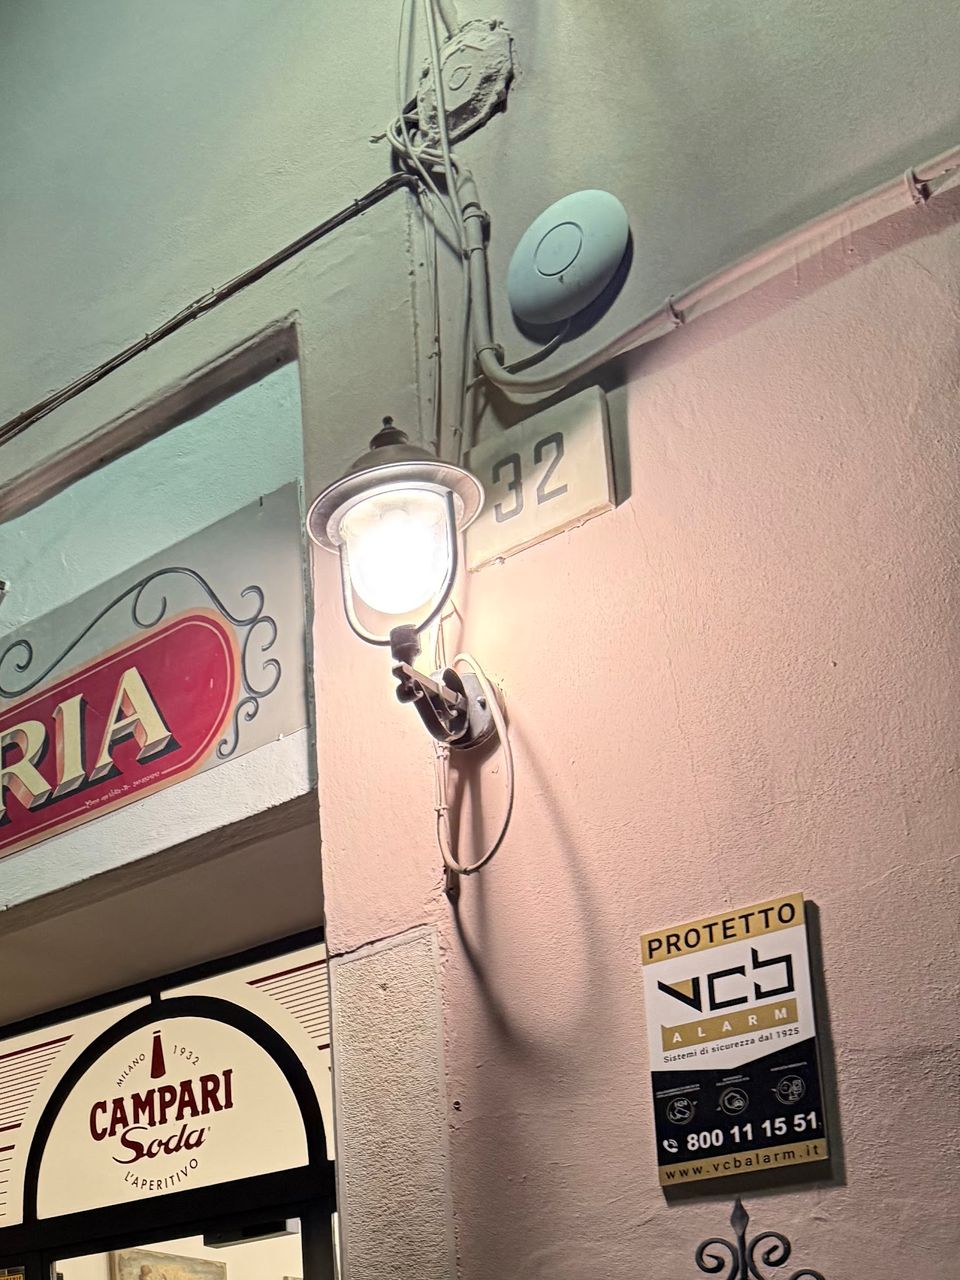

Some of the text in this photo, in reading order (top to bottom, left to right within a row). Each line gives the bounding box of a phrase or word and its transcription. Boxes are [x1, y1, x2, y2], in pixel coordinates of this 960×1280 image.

[492, 431, 568, 523] 32
[648, 902, 796, 959] PROTETTO
[663, 1026, 800, 1063] Sistemi di sicurezza dal 1925
[672, 1007, 788, 1044] ALARM
[116, 1045, 200, 1087] MILANO 1932
[90, 1068, 234, 1142] CAMPARI
[112, 1123, 206, 1164] Soda
[686, 1111, 817, 1151] 800 11 15 51
[124, 1158, 198, 1191] L'APERITIVO
[665, 1144, 819, 1180] www.vcbalarm.it
